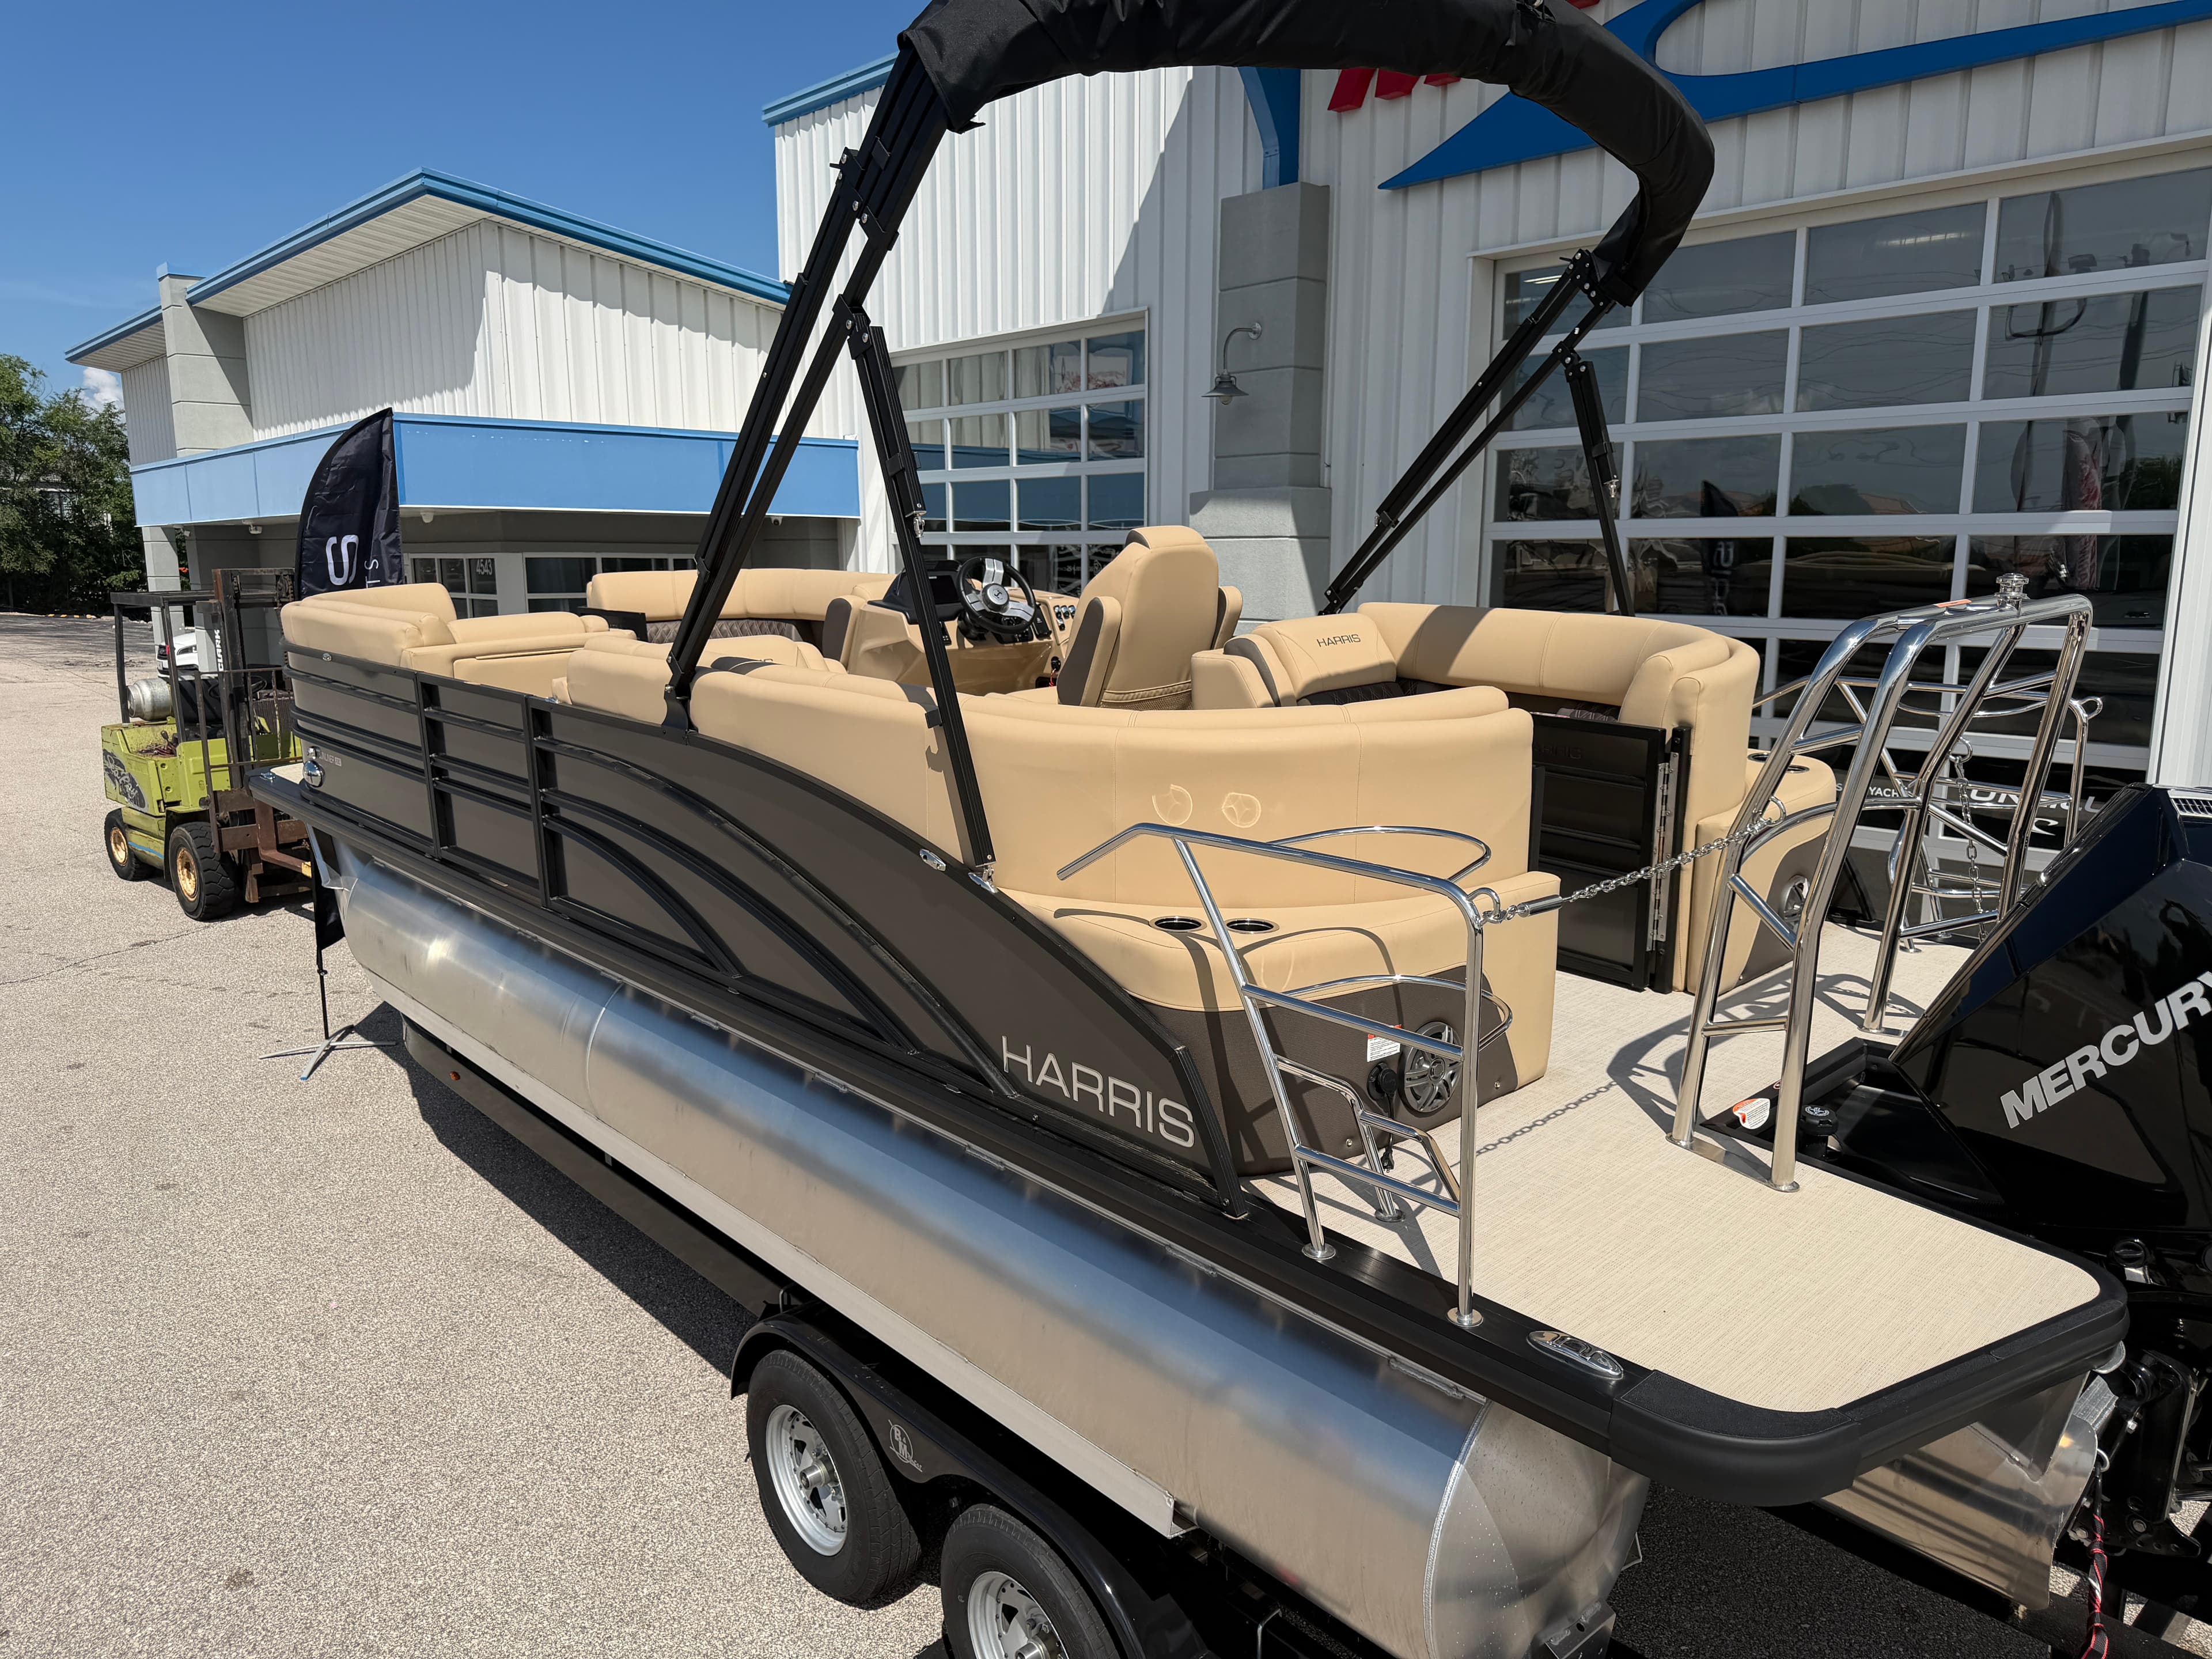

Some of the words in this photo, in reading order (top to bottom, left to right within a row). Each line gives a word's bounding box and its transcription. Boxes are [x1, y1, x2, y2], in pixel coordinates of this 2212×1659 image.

[476, 559, 493, 575] 4543
[1316, 634, 1361, 647] HARRIS
[214, 629, 224, 672] CLARK
[1868, 786, 1900, 798] YACH
[1002, 1035, 1195, 1148] HARRIS
